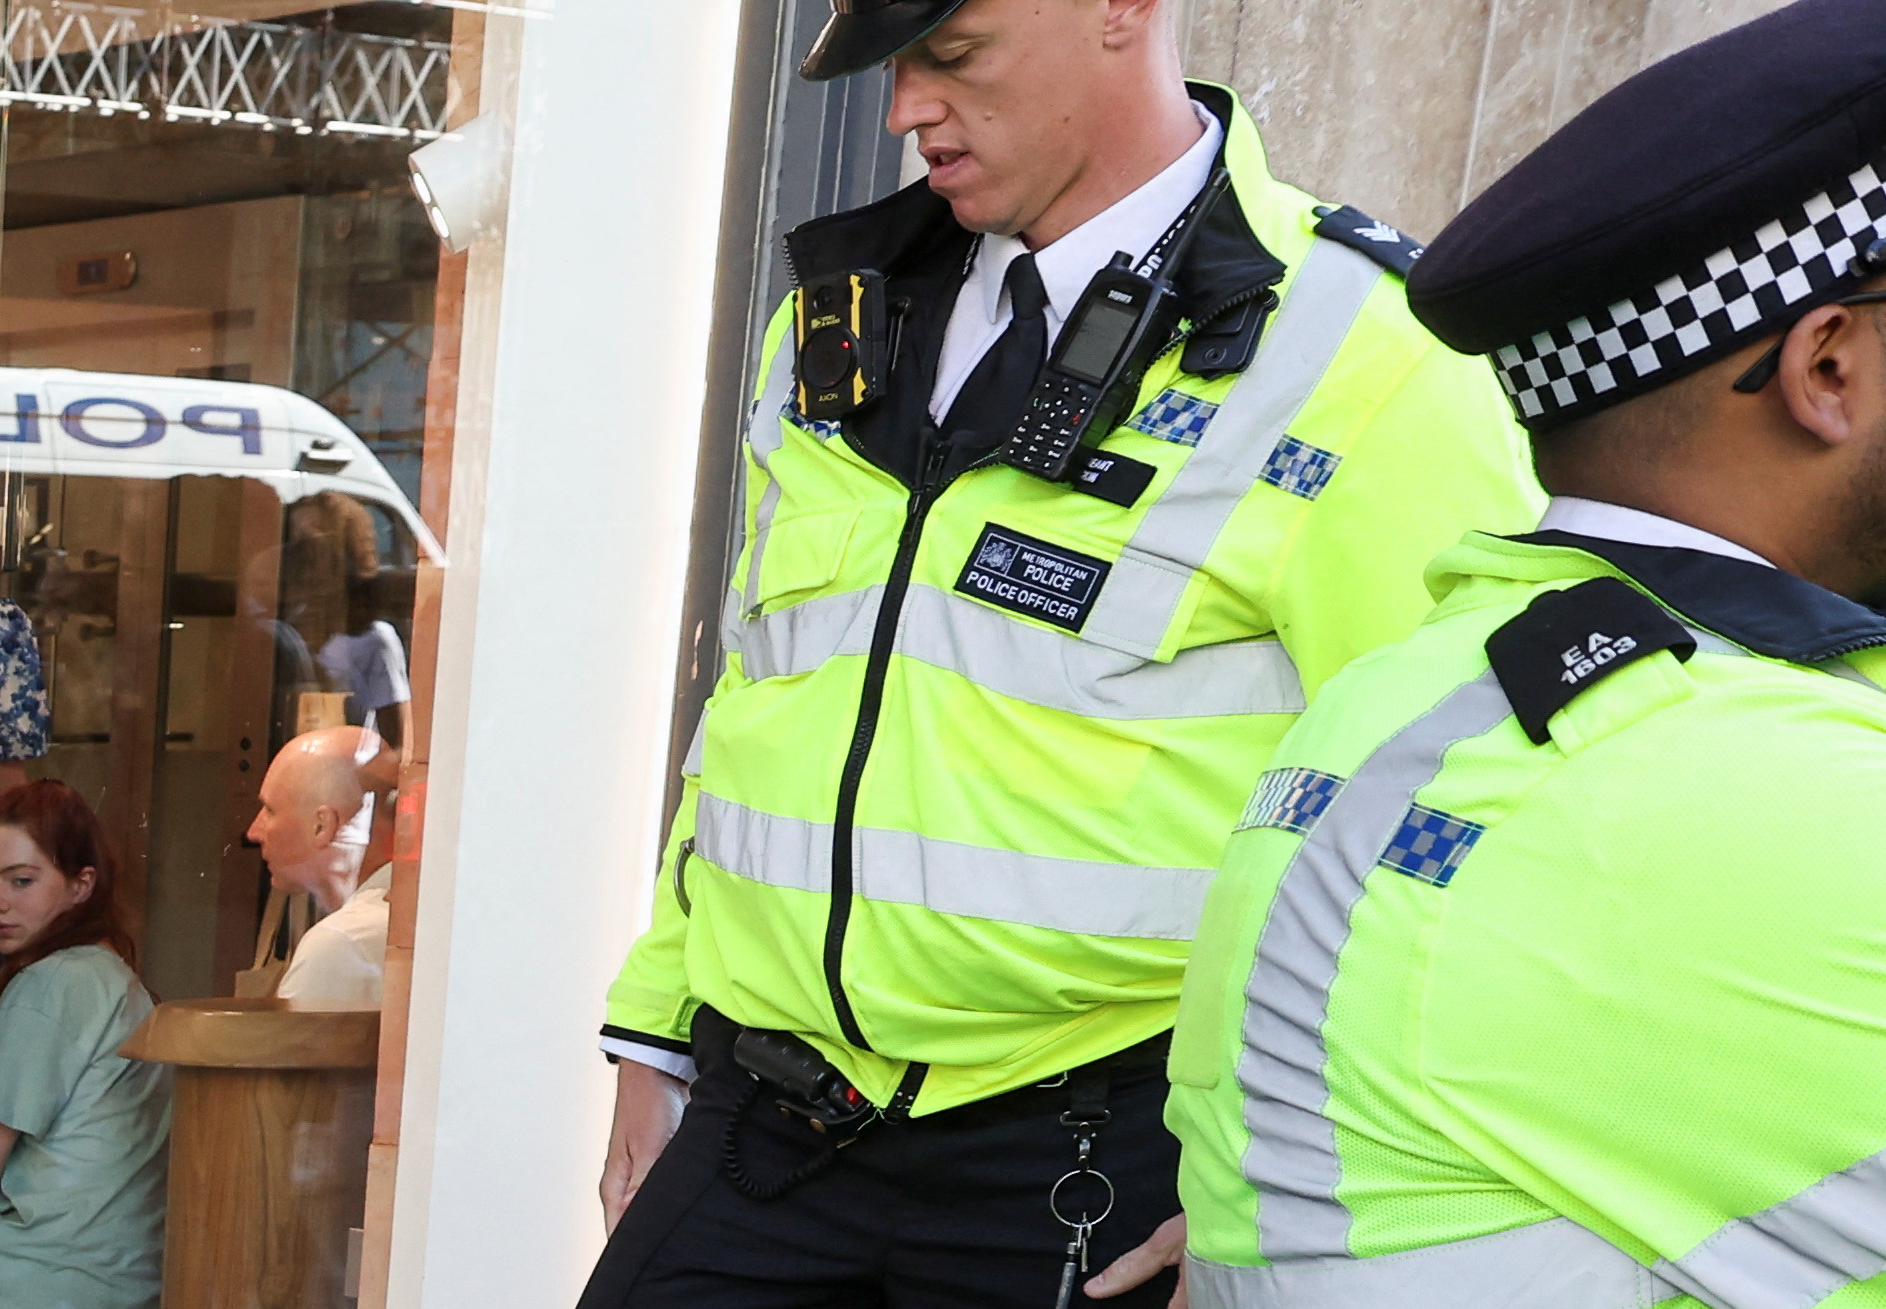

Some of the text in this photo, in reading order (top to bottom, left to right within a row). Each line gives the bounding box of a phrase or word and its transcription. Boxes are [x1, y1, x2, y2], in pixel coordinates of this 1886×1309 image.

[1021, 551, 1089, 580] METROPOLITAN
[1023, 564, 1075, 592] POLICE
[966, 571, 1079, 620] POLICE OFFICER
[1560, 632, 1613, 667] EA
[1560, 636, 1637, 685] 1603
